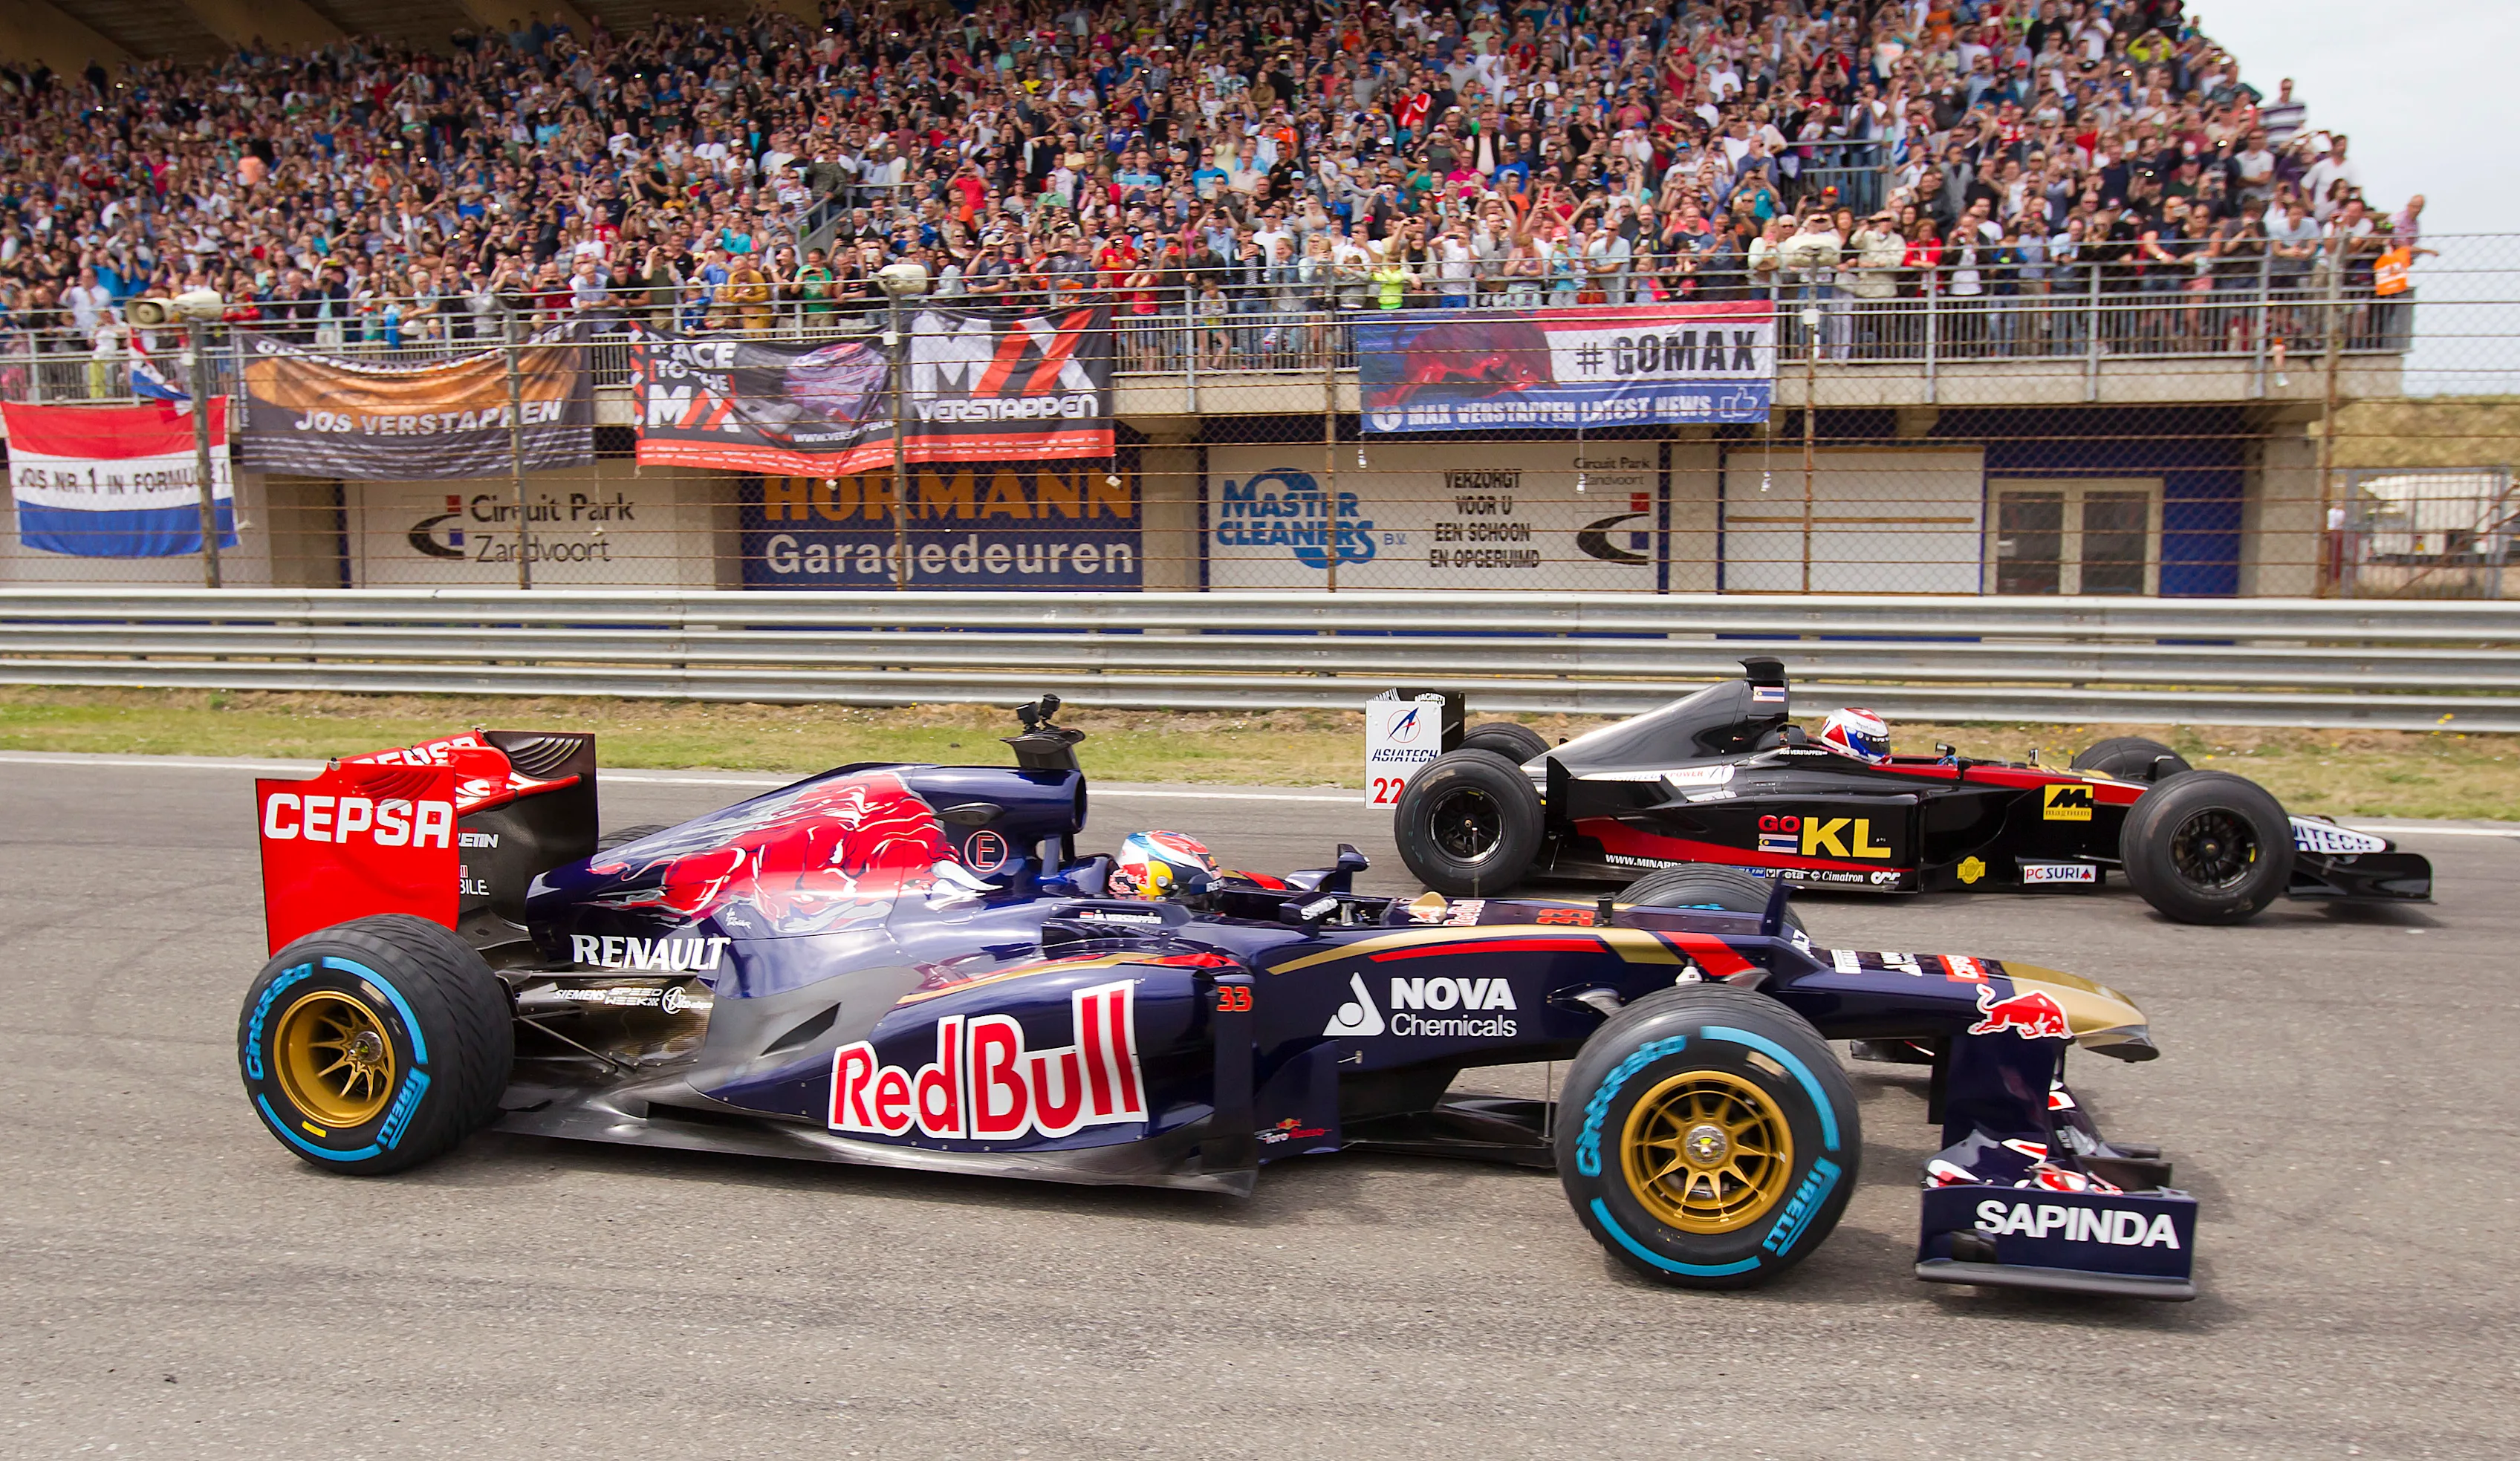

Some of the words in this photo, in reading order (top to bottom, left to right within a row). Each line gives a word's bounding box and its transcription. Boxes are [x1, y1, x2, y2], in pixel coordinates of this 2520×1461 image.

[656, 359, 689, 379] TO
[294, 409, 353, 434] JOS
[360, 397, 562, 436] VERSTAPPEN
[1408, 403, 1451, 426] MAX
[1457, 400, 1575, 423] VERSTAPPEN
[1580, 396, 1649, 420] LATEST
[1655, 394, 1712, 418] NEWS
[1574, 456, 1617, 469] Circuit
[1620, 456, 1651, 469] Park
[88, 466, 97, 494] 1
[107, 474, 125, 495] IN
[133, 466, 215, 493] FORMU
[1444, 469, 1522, 489] VERZORGT
[570, 492, 634, 521] Park
[1455, 495, 1496, 515] VOOR
[1502, 495, 1513, 515] U
[1435, 522, 1463, 541] EEN
[1467, 522, 1530, 541] SCHOON
[766, 533, 1134, 582] Garagedeuren
[1429, 549, 1449, 568] EN
[1455, 549, 1540, 568] OPGERUIMD
[1372, 749, 1439, 763] ASIATECH
[1373, 777, 1406, 804] 22
[264, 793, 454, 849] CEPSA
[1758, 814, 1802, 833] GO
[1802, 816, 1891, 859] KL
[1605, 853, 1683, 870] WWW.MINAR
[2026, 868, 2044, 879] PC
[1822, 871, 1864, 883] Cimatron
[570, 934, 732, 971] RENAULT
[553, 989, 607, 1002] SIEMENS
[604, 996, 649, 1006] WEEK
[608, 987, 664, 997] SPEED
[1216, 986, 1254, 1012] 33
[1391, 977, 1518, 1011] NOVA
[1391, 1013, 1518, 1037] Chemicals
[828, 1014, 967, 1139] Red
[968, 980, 1149, 1141] Bull
[375, 1065, 432, 1151] PIRELLI
[1761, 1156, 1842, 1257] PIRELLI
[1974, 1200, 2180, 1250] SAPINDA
